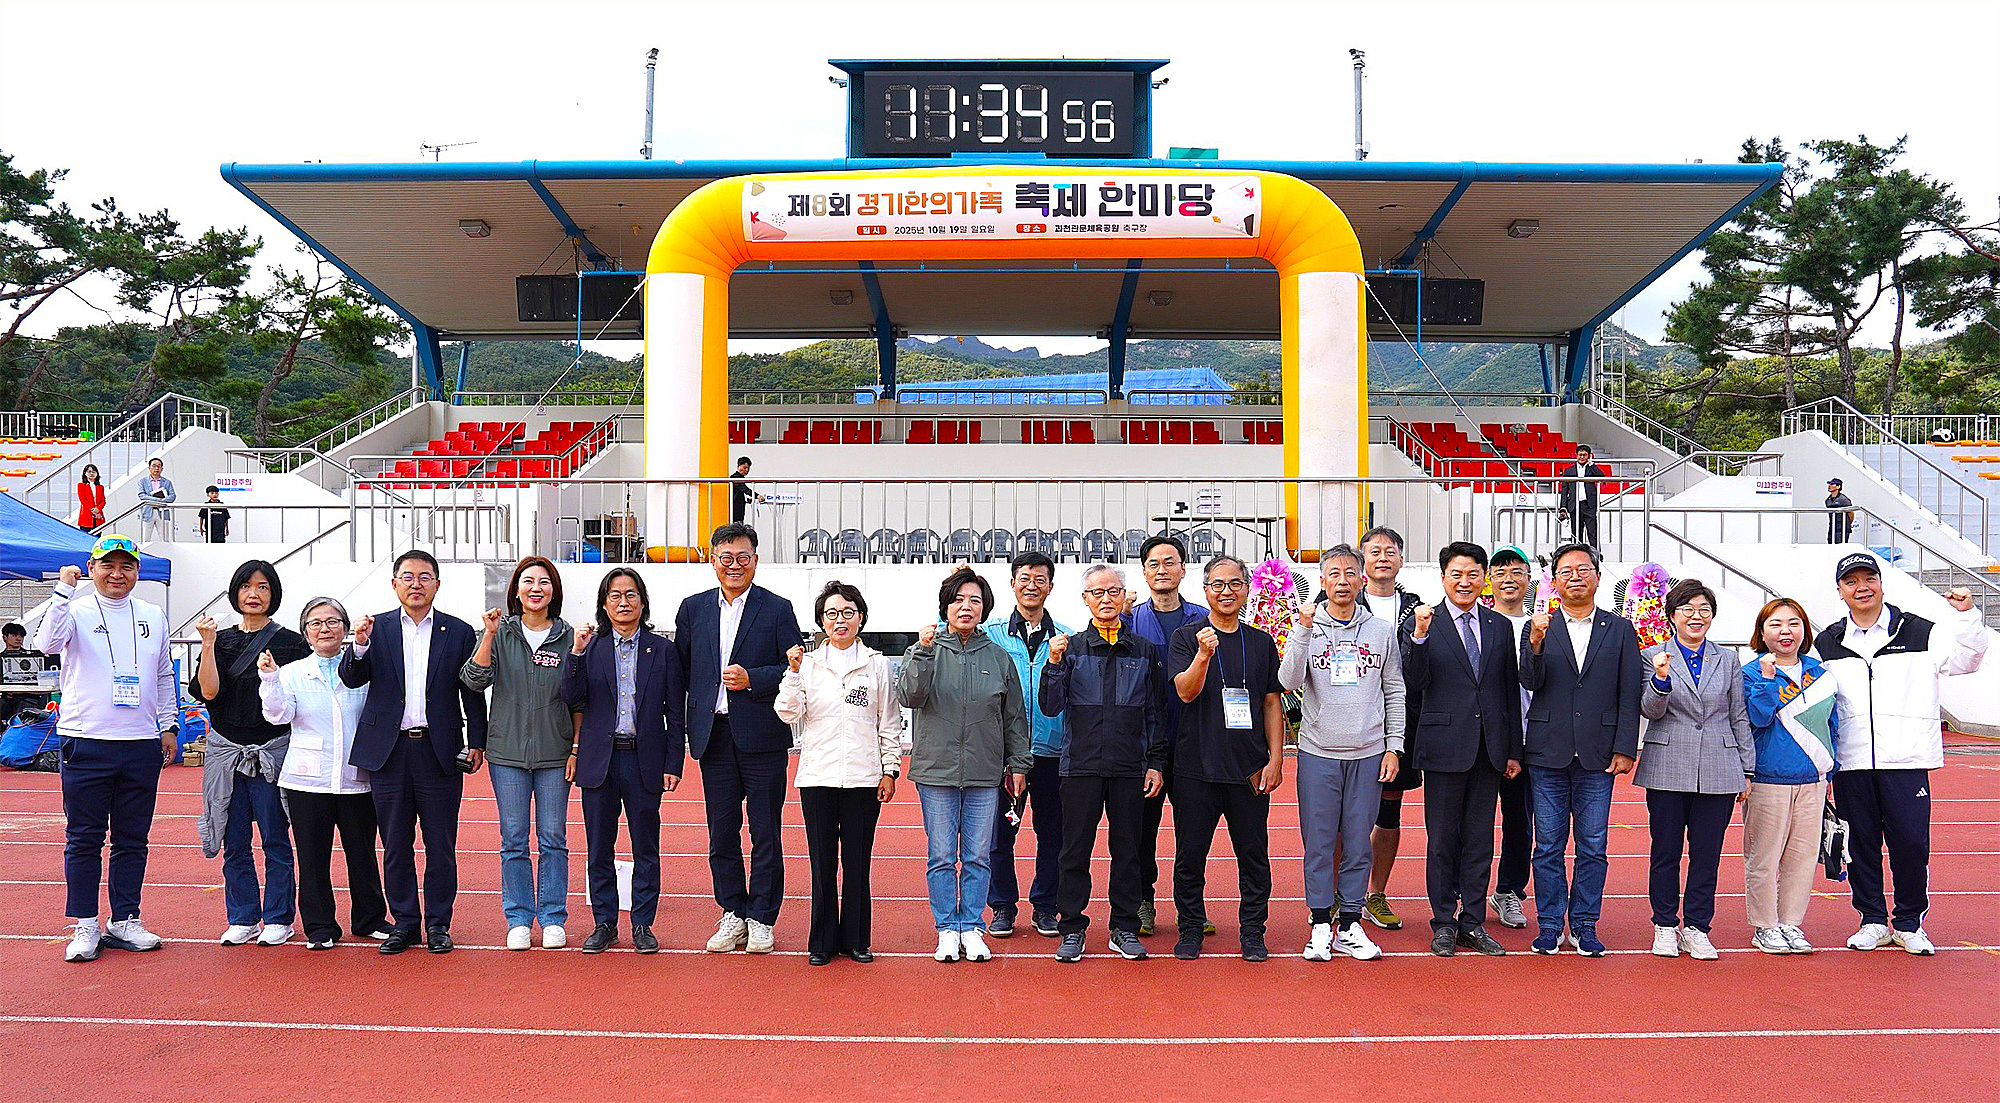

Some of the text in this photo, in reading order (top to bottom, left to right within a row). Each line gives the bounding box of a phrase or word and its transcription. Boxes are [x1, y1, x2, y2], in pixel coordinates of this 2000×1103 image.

[908, 83, 1116, 144] 11:34 56
[787, 181, 1216, 218] 제8회 경기한의가족 축제 한마당
[894, 225, 925, 235] 2025년
[928, 225, 946, 235] 10월
[949, 225, 968, 235] 19일
[970, 224, 995, 234] 일요일
[1054, 223, 1120, 233] 과천관문체육공원
[1122, 223, 1148, 233] 축구장
